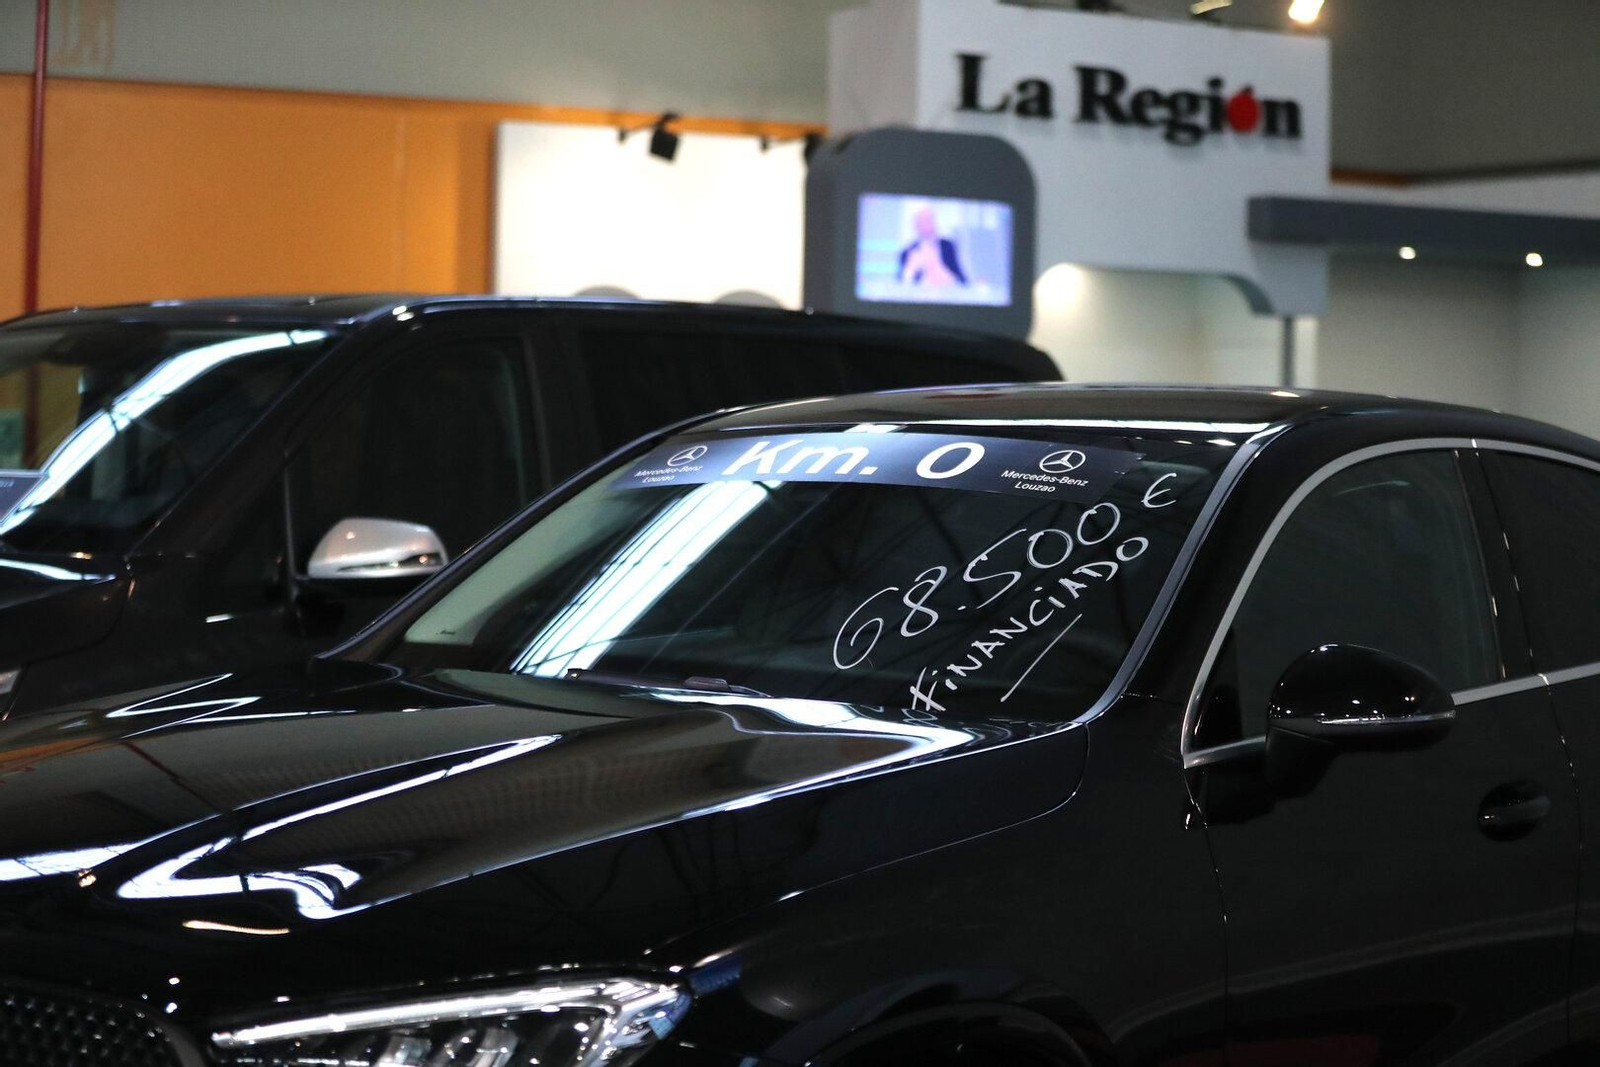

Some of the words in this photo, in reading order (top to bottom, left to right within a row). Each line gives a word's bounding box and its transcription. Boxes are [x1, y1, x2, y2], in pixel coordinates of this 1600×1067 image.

[955, 53, 1054, 119] La
[722, 439, 879, 476] Km.
[634, 465, 703, 478] Mercedes-Benz
[1001, 470, 1089, 487] Mercedes-Benz
[1014, 481, 1056, 493] Louzao
[833, 502, 1121, 669] 68.500
